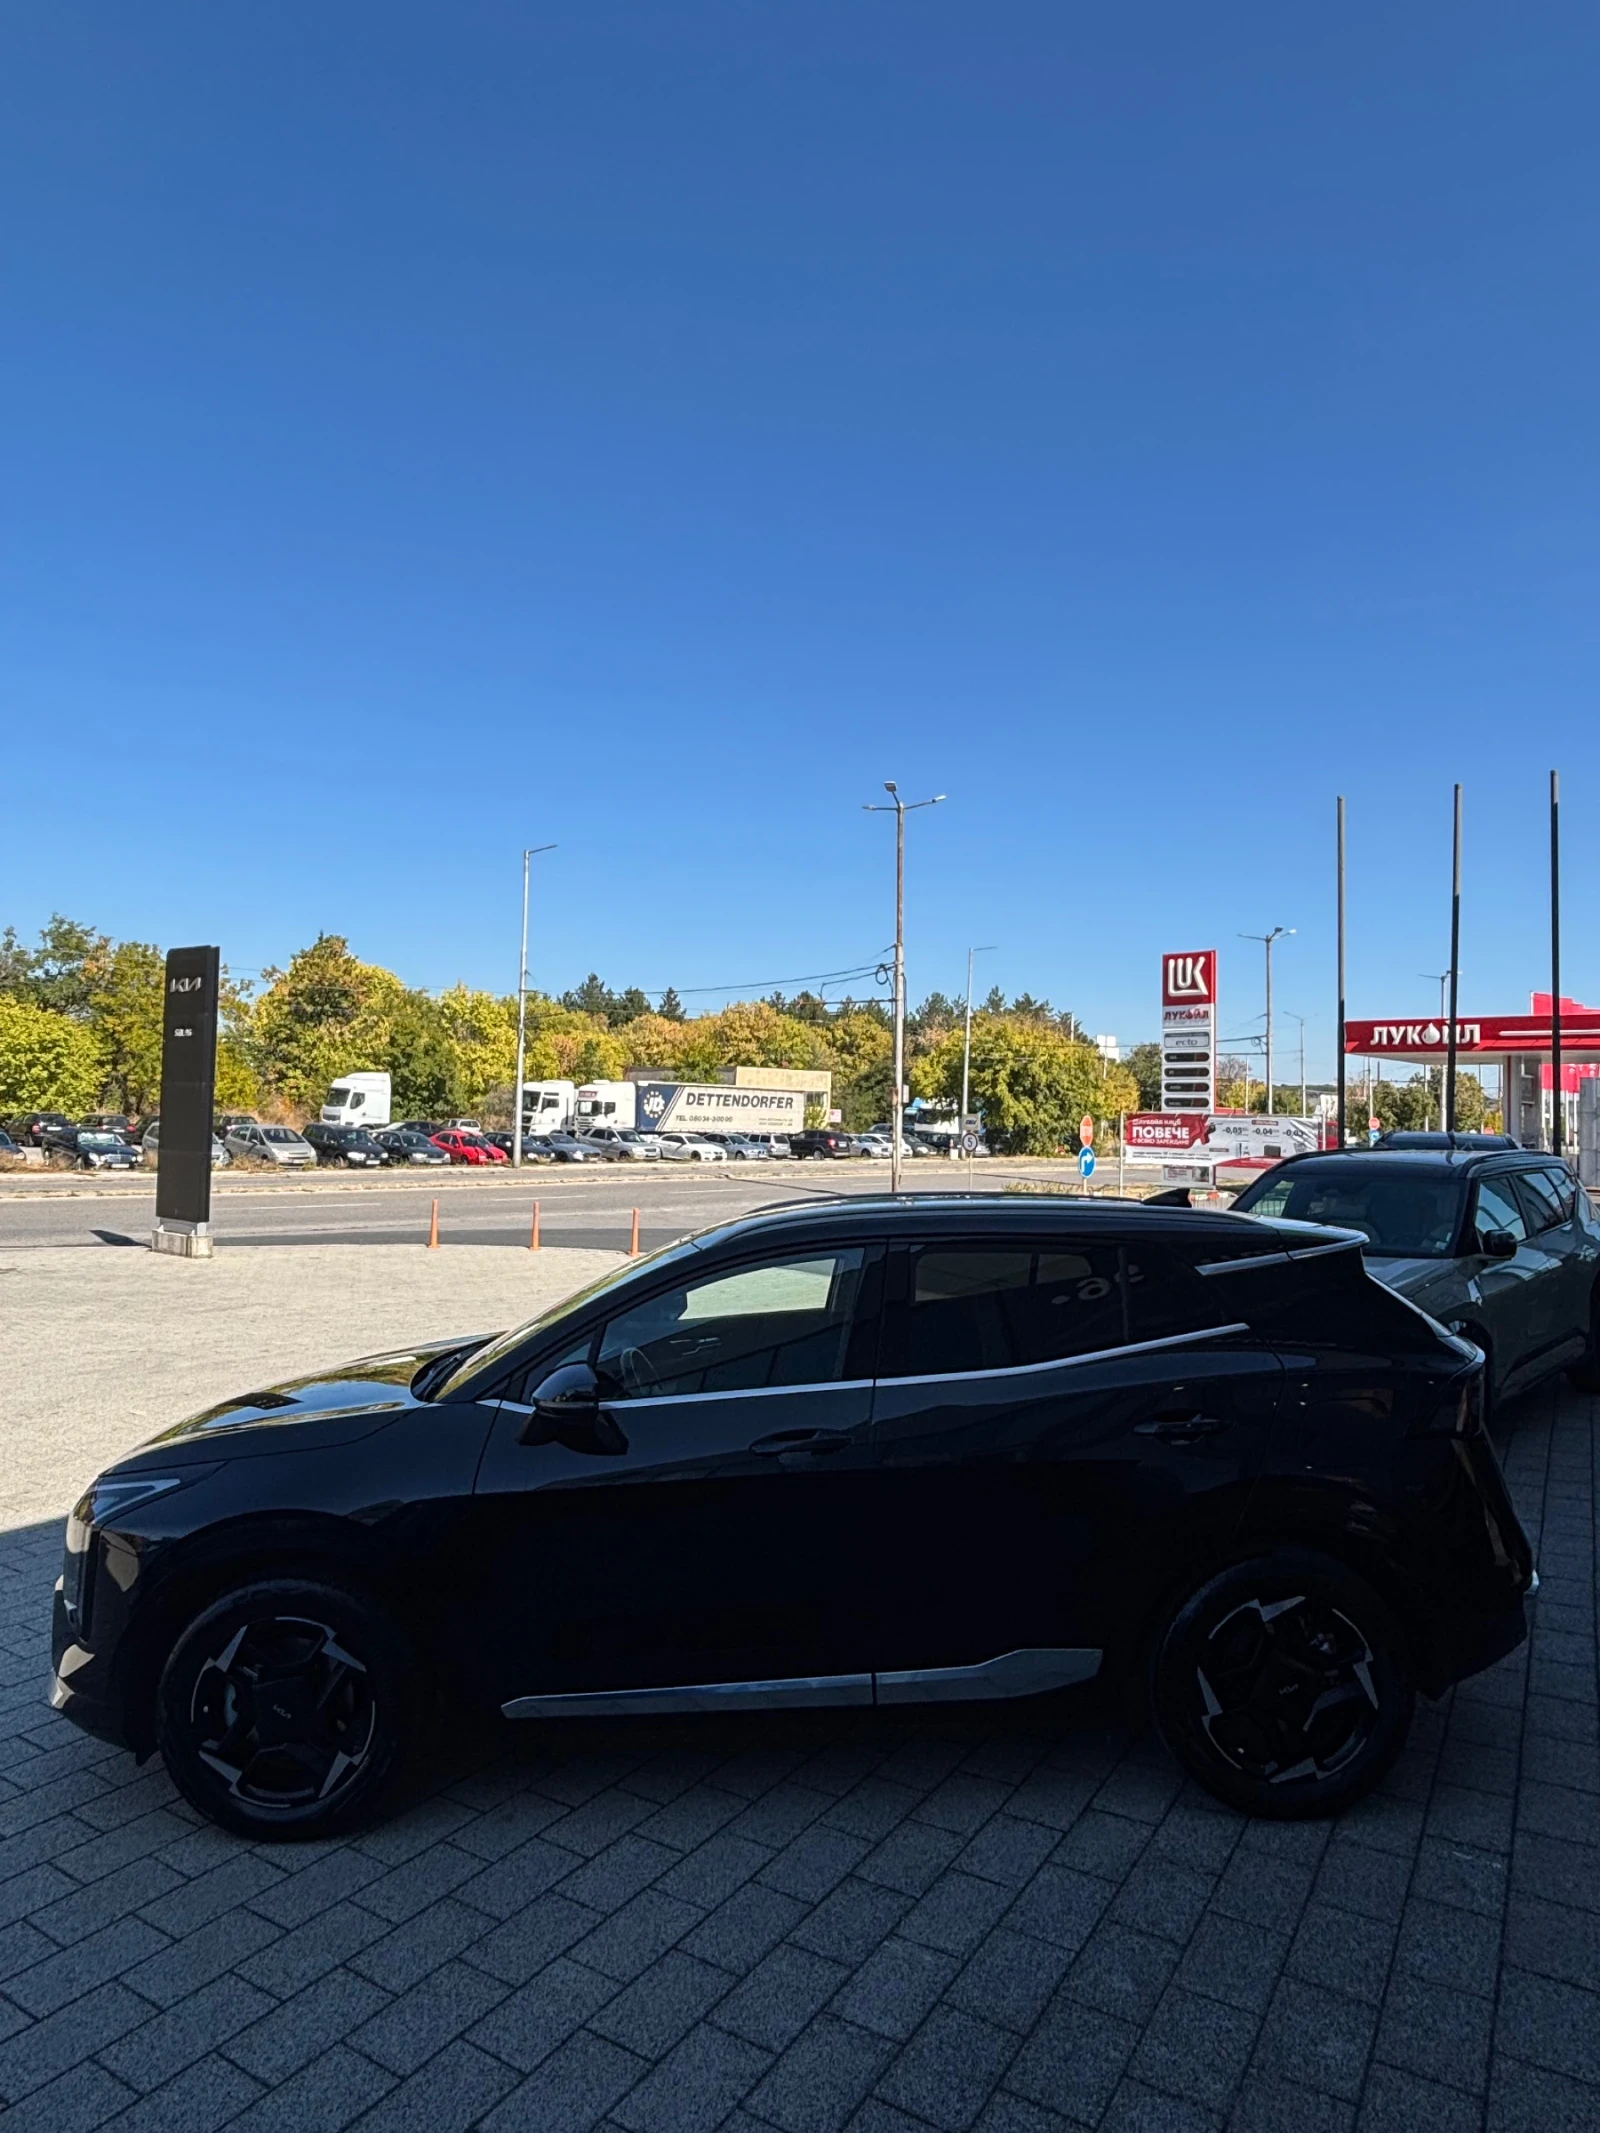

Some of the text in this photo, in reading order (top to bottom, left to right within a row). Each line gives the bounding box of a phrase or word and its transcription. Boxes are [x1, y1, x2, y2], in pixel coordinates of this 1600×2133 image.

[686, 1092, 794, 1109] DETTENDORFER
[1132, 1126, 1189, 1139] ПОВЕЧЕ
[967, 1137, 973, 1148] 5
